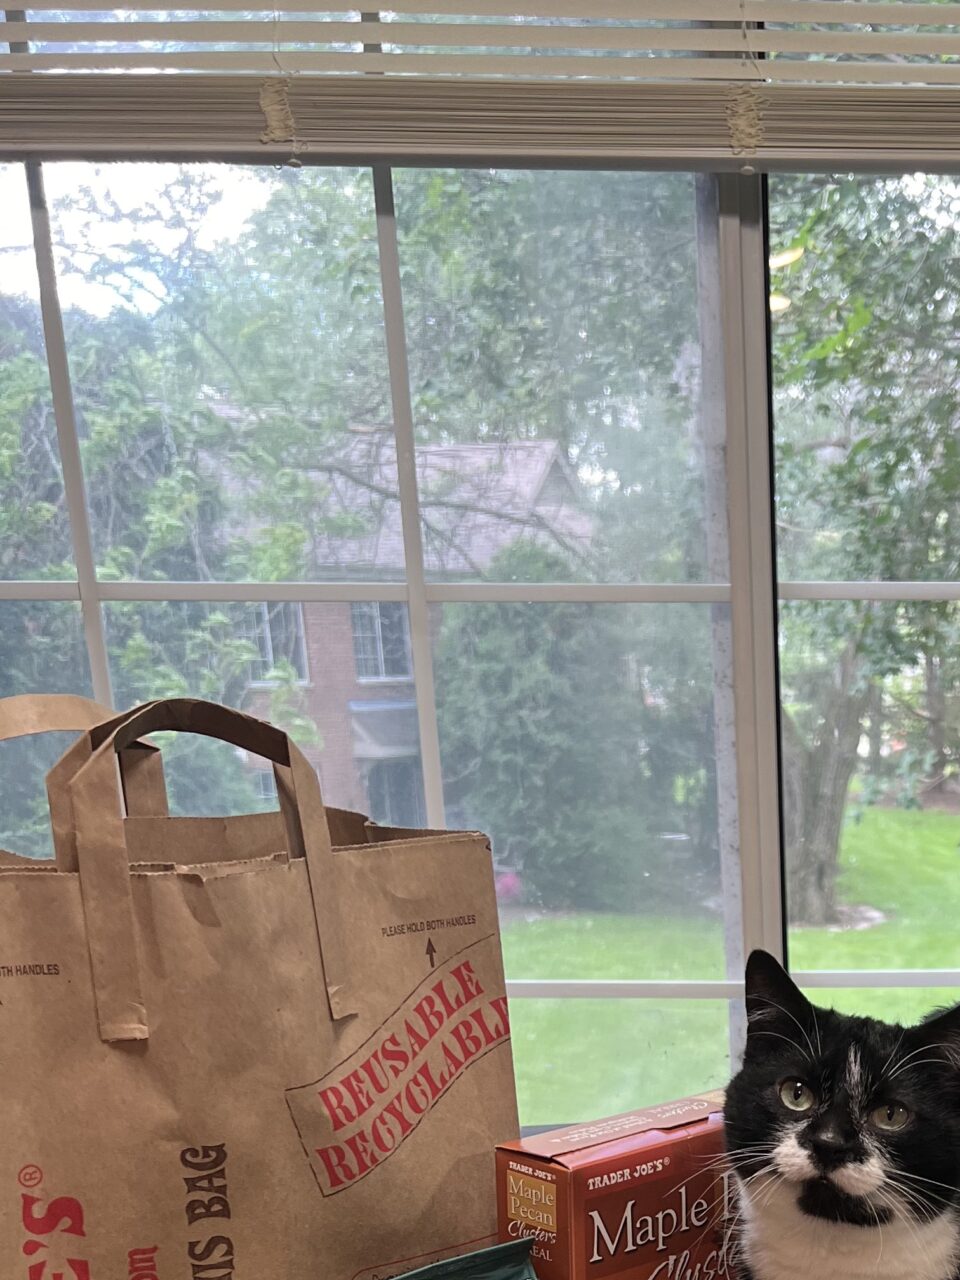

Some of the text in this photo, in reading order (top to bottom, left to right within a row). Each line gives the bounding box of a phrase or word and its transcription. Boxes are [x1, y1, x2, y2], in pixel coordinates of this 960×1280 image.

[381, 914, 477, 937] PLEASE HOLD BOTH HANDLES
[15, 963, 60, 976] HANDLES
[318, 959, 485, 1131] REUSABLE
[508, 1161, 533, 1176] TRADER
[588, 1169, 631, 1191] TRADER
[180, 1143, 232, 1225] BAG
[508, 1175, 555, 1206] Maple
[510, 1196, 554, 1227] Pecan
[507, 1220, 557, 1245] Clusters
[588, 1186, 709, 1264] Maple
[530, 1245, 553, 1262] EAL
